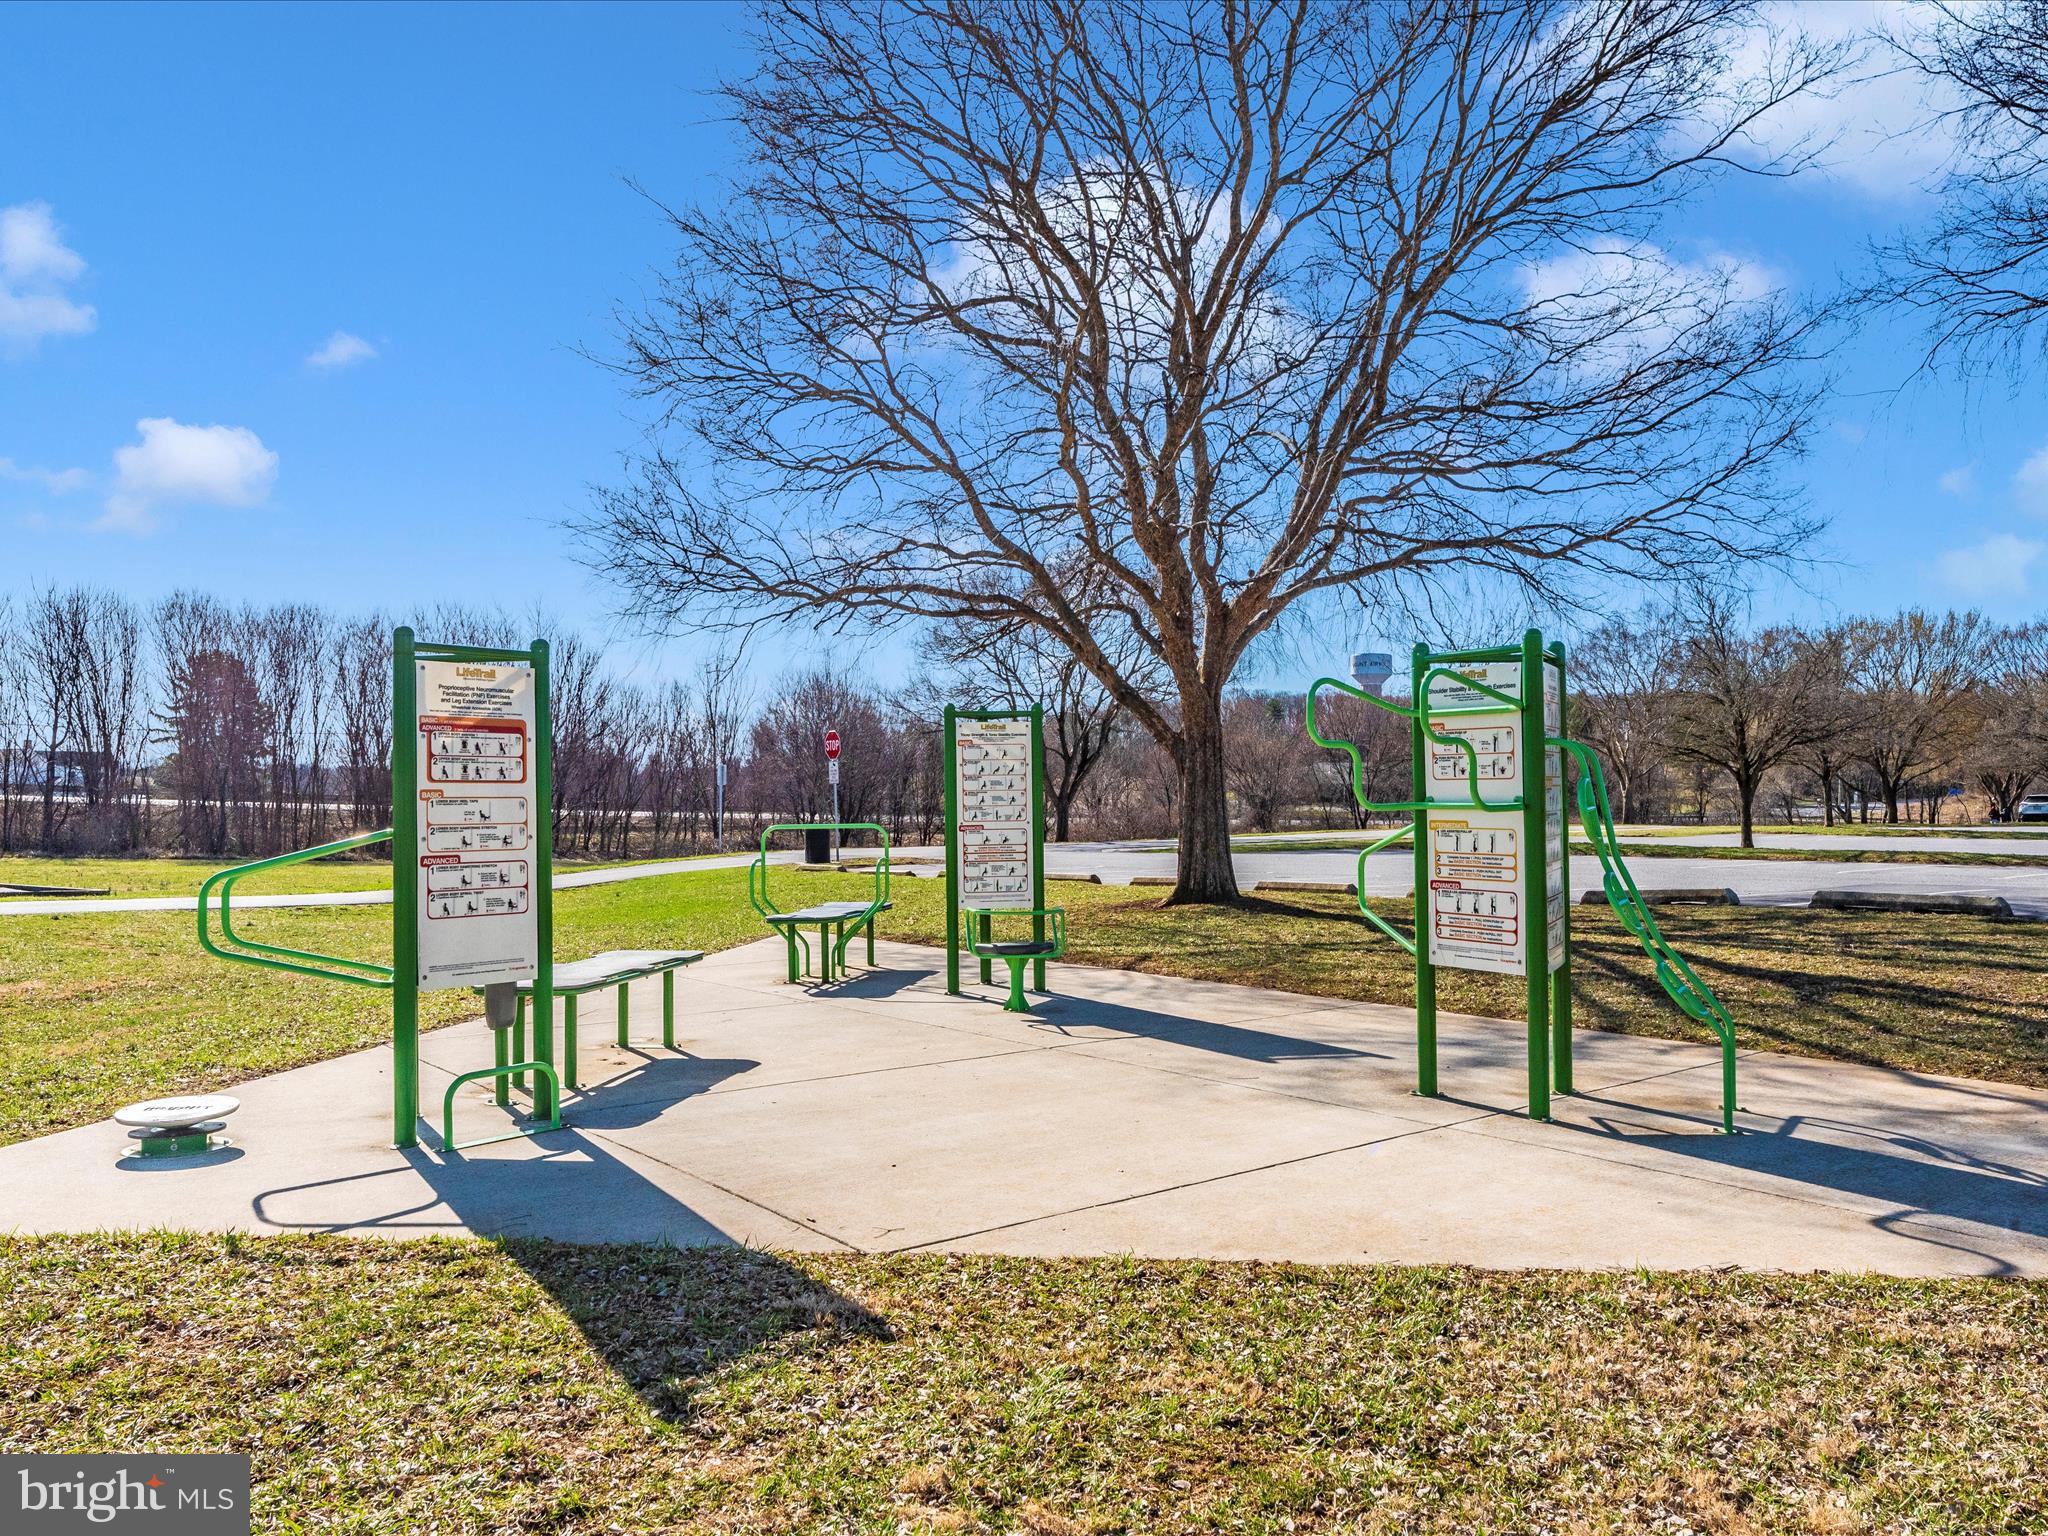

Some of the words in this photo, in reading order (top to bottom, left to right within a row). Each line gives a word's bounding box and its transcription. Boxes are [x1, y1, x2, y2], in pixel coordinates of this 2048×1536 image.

[456, 666, 496, 679] LifeTrail
[438, 684, 475, 693] Proprioceptive
[476, 686, 514, 694] Neuromuscular
[442, 690, 470, 698] Facilitation
[487, 692, 510, 700] Exercises
[433, 732, 437, 740] 1
[826, 740, 839, 751] STOP
[432, 757, 438, 765] 2
[1434, 756, 1439, 764] 2
[430, 800, 434, 808] 1
[430, 827, 435, 835] 2
[423, 857, 459, 865] ADVANCED
[430, 867, 434, 875] 1
[430, 894, 435, 902] 2
[1437, 914, 1442, 922] 2
